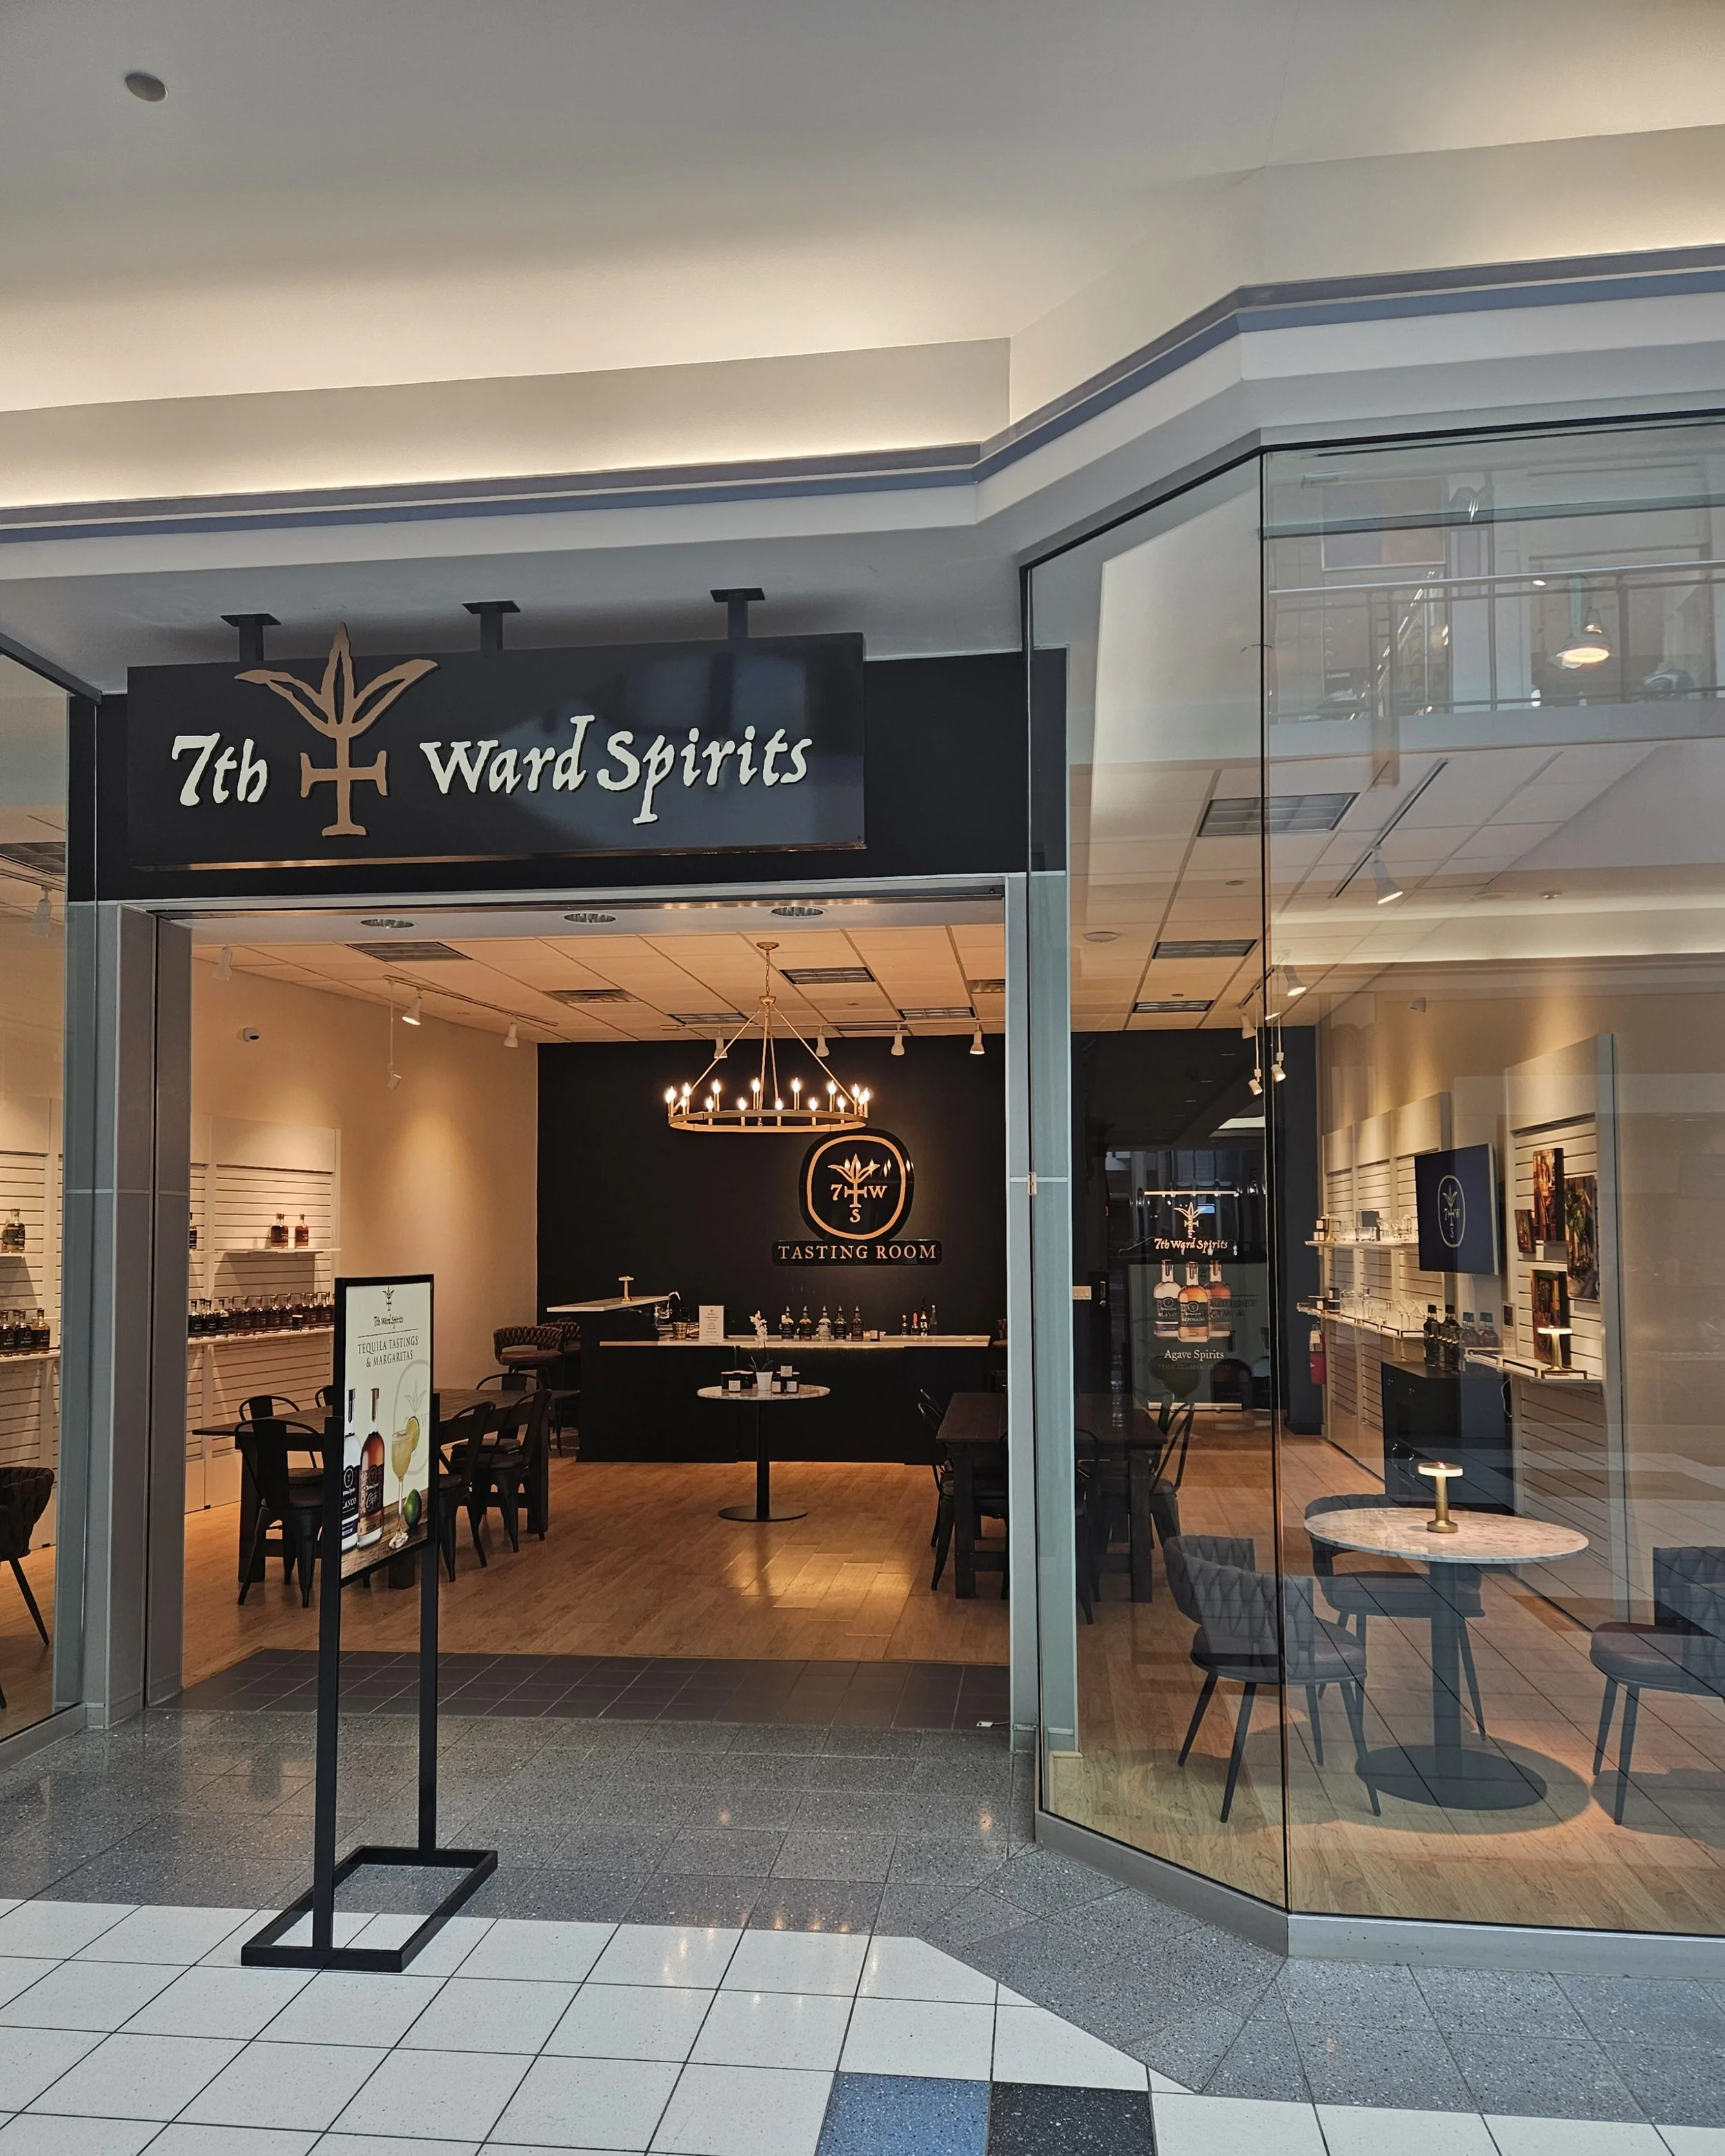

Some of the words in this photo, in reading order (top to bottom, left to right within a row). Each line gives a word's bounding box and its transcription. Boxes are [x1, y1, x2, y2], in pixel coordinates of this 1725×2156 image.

[170, 733, 268, 807] 7th
[419, 715, 595, 795] Ward
[595, 725, 814, 824] Spirits
[830, 1183, 843, 1201] 7
[867, 1185, 888, 1199] W
[849, 1208, 861, 1223] S
[778, 1245, 868, 1259] TASTING
[876, 1244, 936, 1259] ROOM
[1154, 1238, 1170, 1249] 7th
[1170, 1237, 1196, 1249] Ward
[1196, 1239, 1228, 1254] Spirits
[358, 1341, 386, 1354] TEQUILA
[388, 1336, 418, 1349] TASTINGS
[366, 1358, 371, 1367] &
[373, 1350, 413, 1366] MARGARITAS
[1164, 1350, 1192, 1361] Agave
[1194, 1350, 1224, 1362] Spirits
